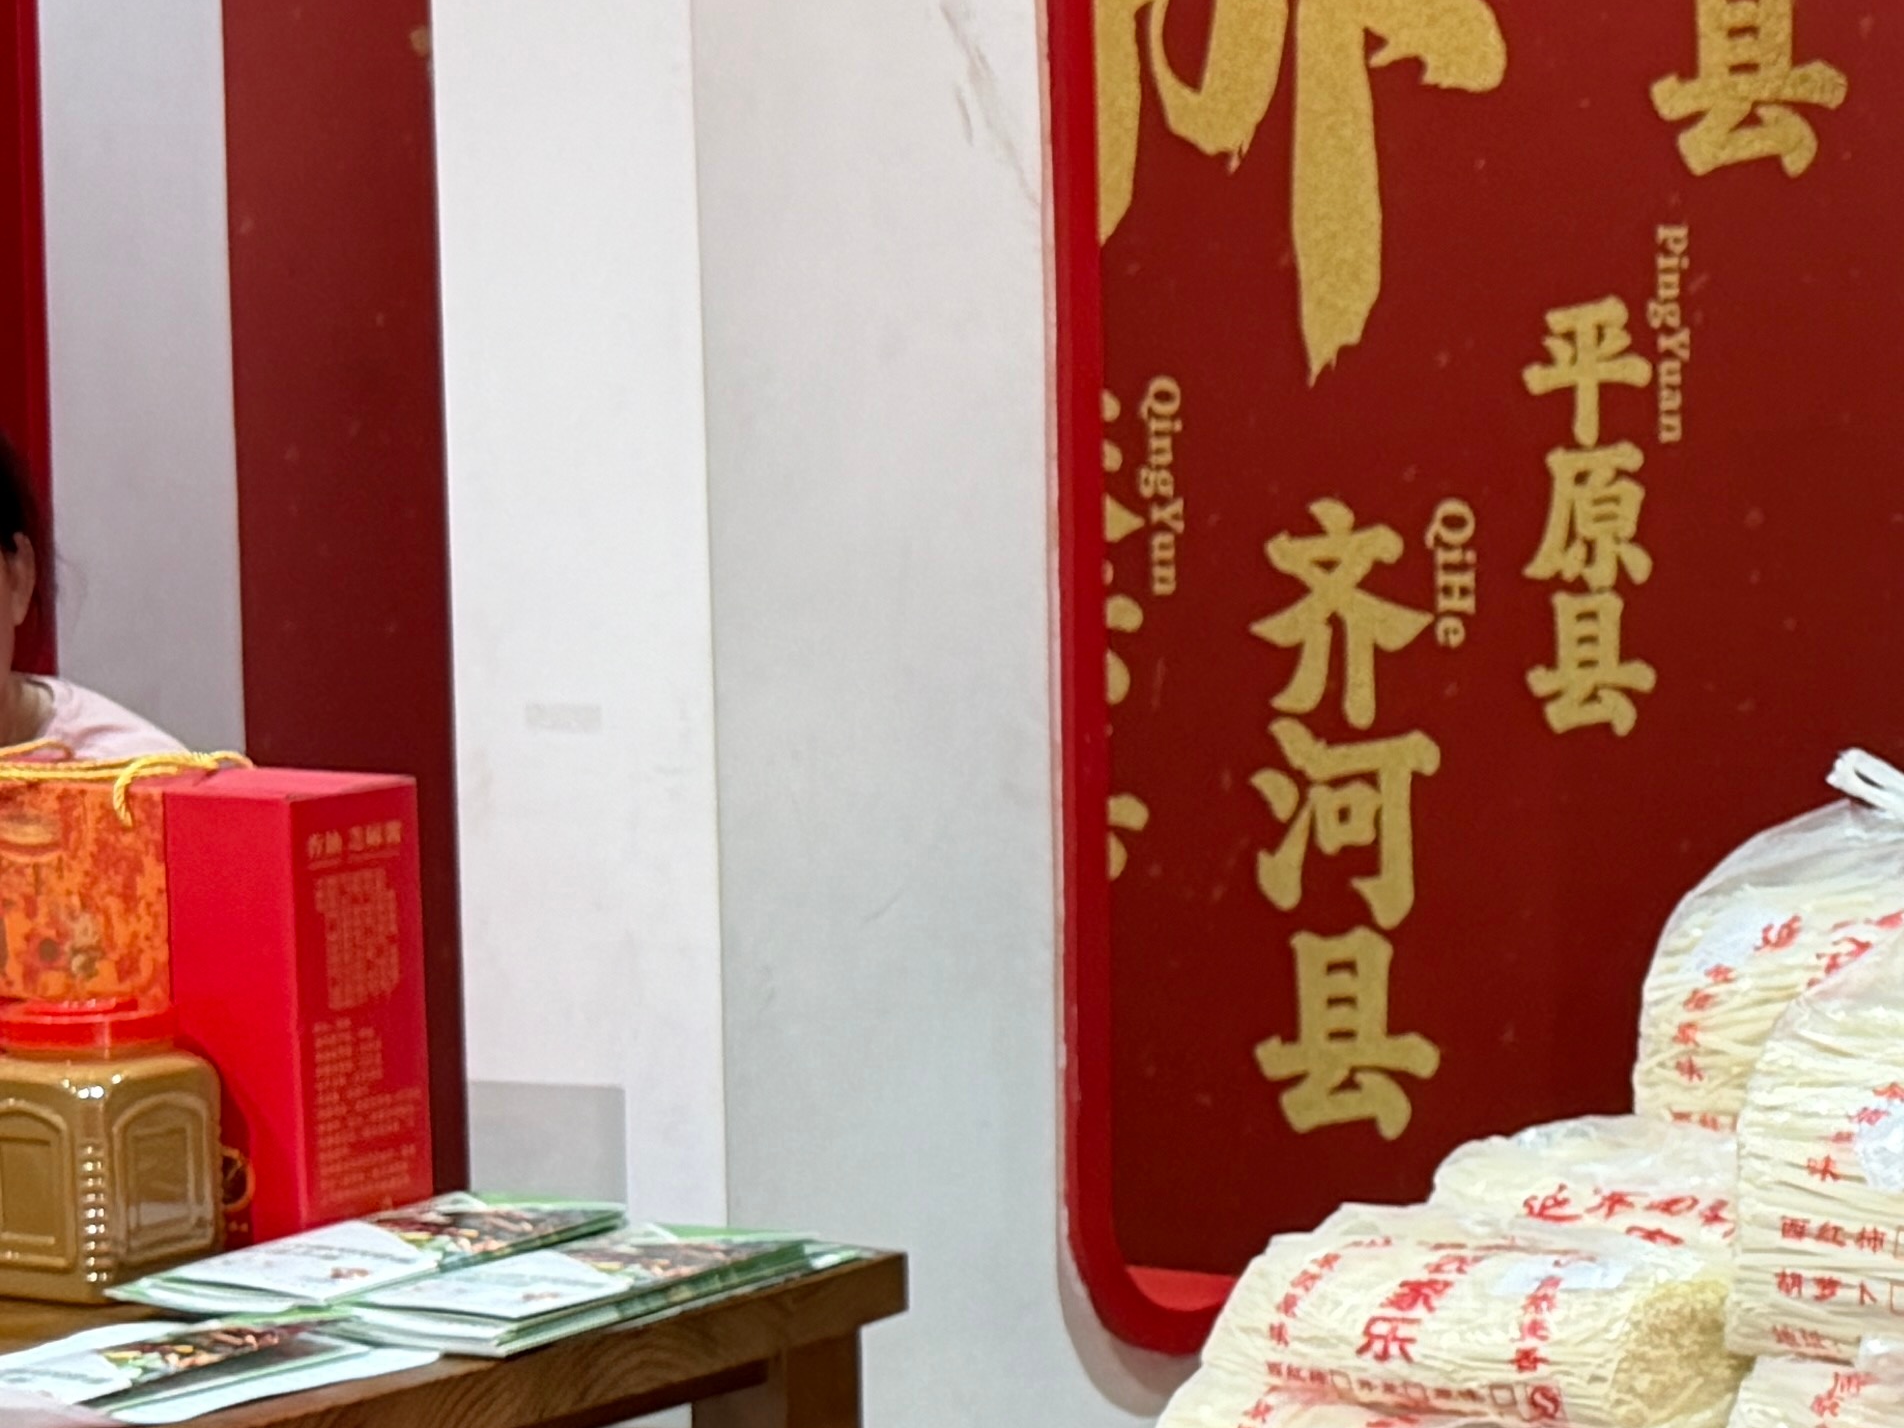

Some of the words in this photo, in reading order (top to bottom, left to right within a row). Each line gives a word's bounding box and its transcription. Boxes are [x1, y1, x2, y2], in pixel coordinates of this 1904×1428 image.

[1650, 222, 1693, 446] PingYuan
[1139, 374, 1186, 597] QingYun
[1424, 497, 1478, 650] QiHe
[1520, 294, 1659, 739] 平原县
[1248, 497, 1445, 1143] 齐河县
[1775, 1270, 1878, 1307] 胡萝卜
[1780, 1215, 1886, 1254] 西红柿
